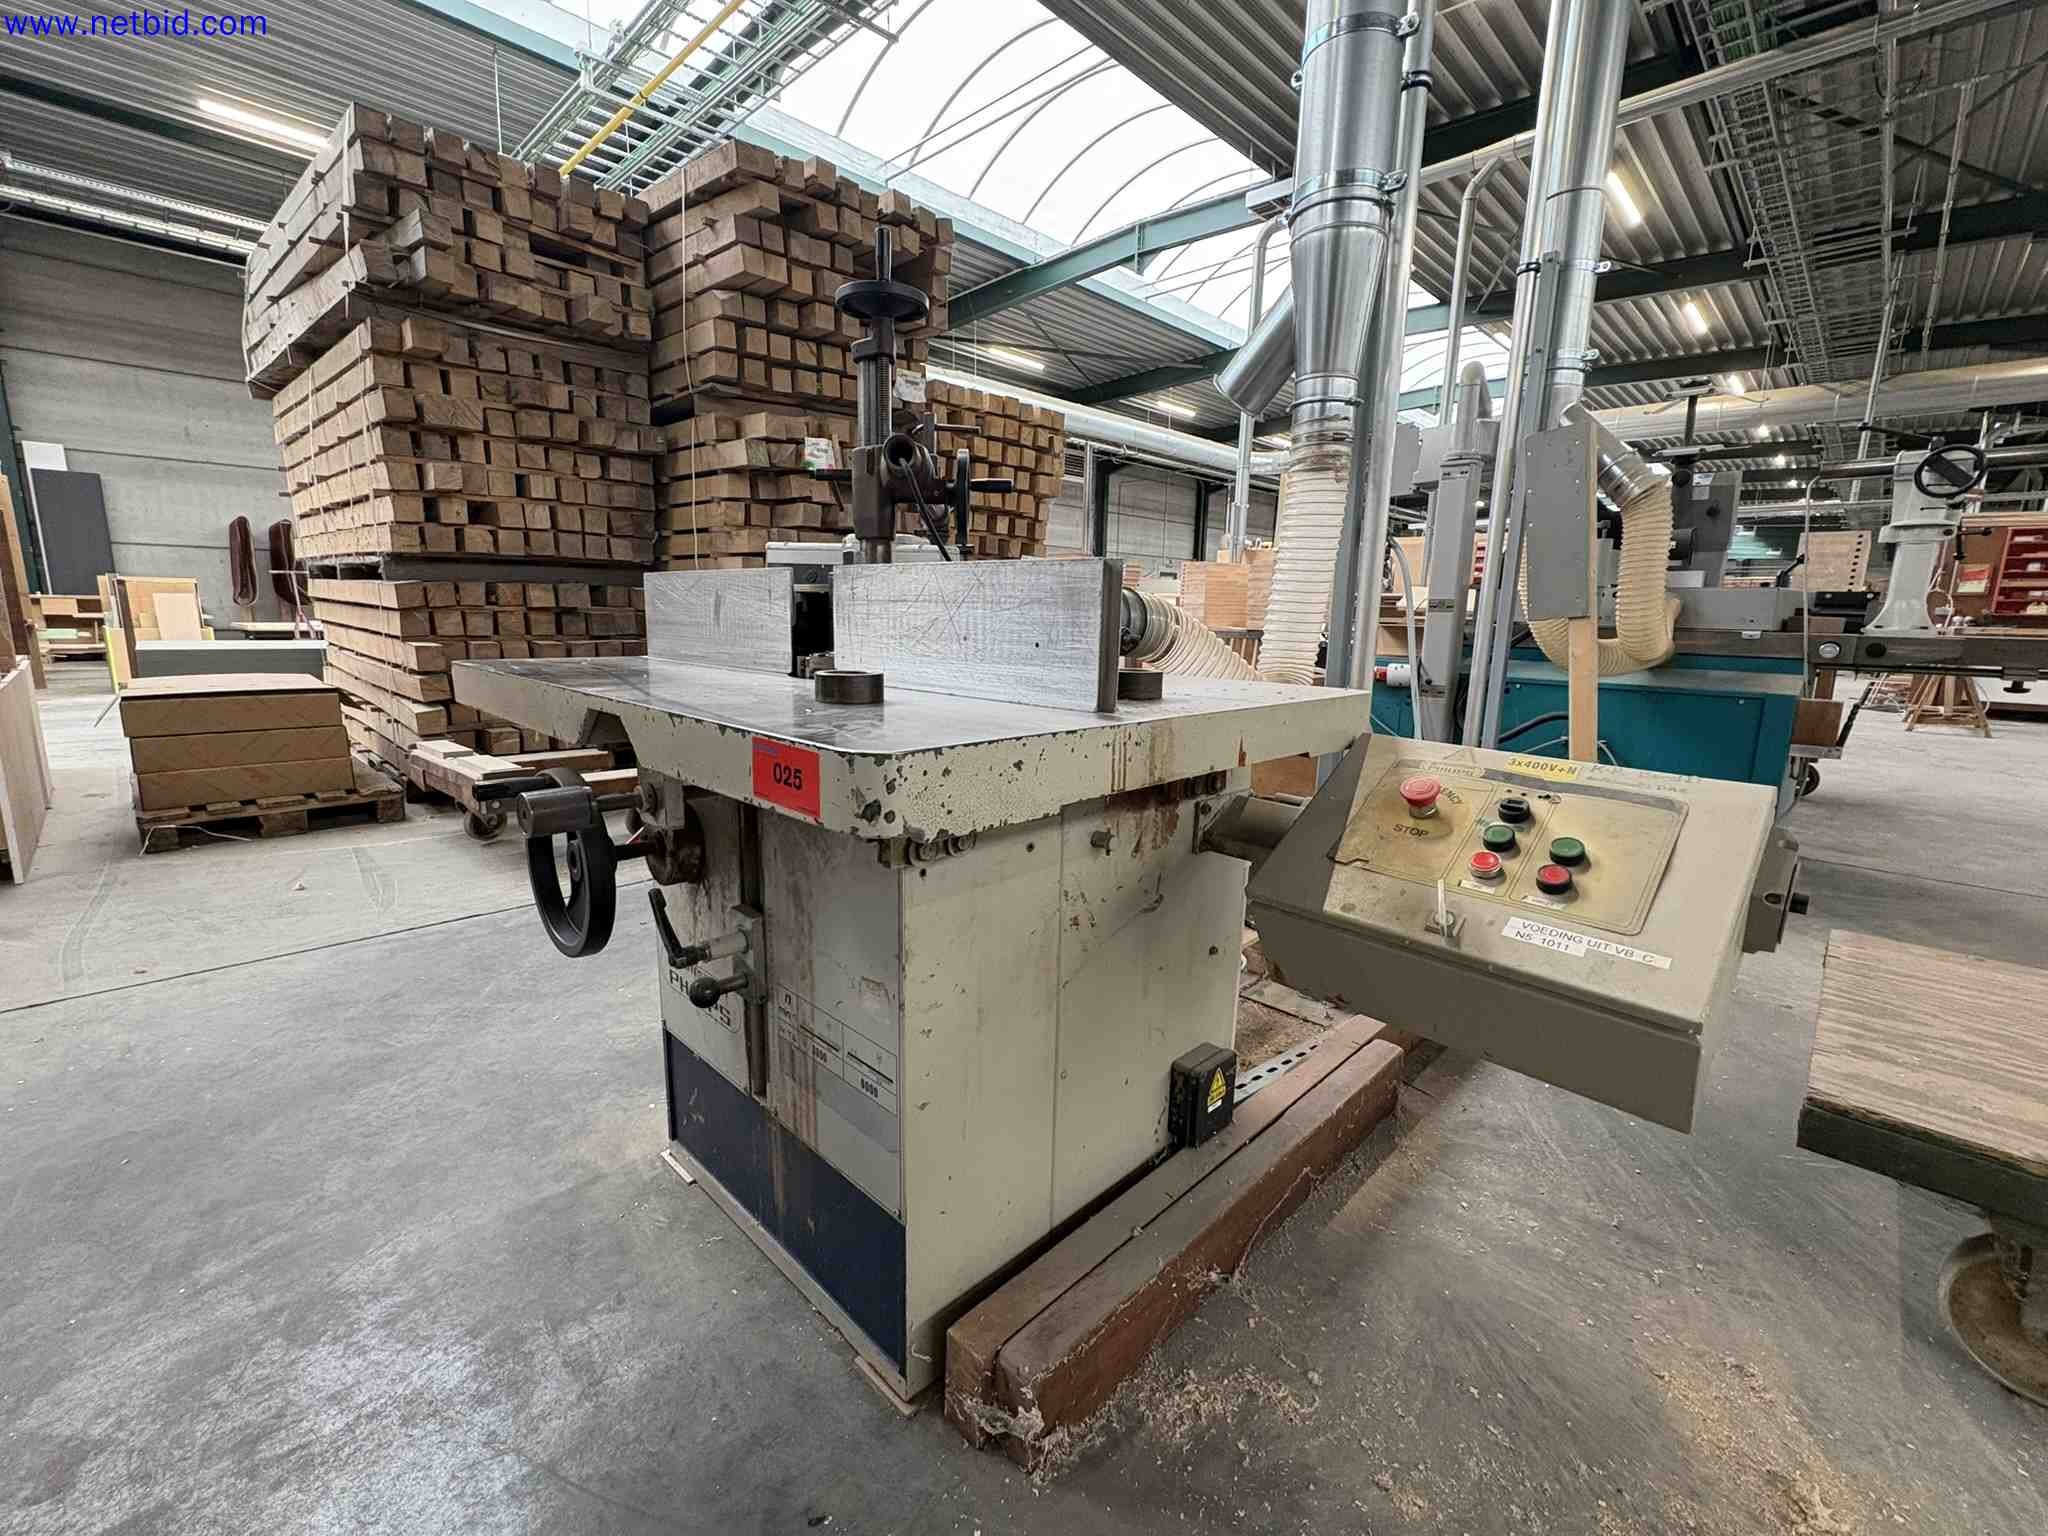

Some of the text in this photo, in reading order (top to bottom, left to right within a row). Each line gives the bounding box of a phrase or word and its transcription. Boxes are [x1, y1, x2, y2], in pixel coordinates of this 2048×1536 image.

[773, 762, 802, 791] 025
[1393, 823, 1429, 837] STOP
[1521, 921, 1584, 945] VOEDING
[1586, 938, 1611, 951] UIT
[1615, 945, 1634, 958] VB
